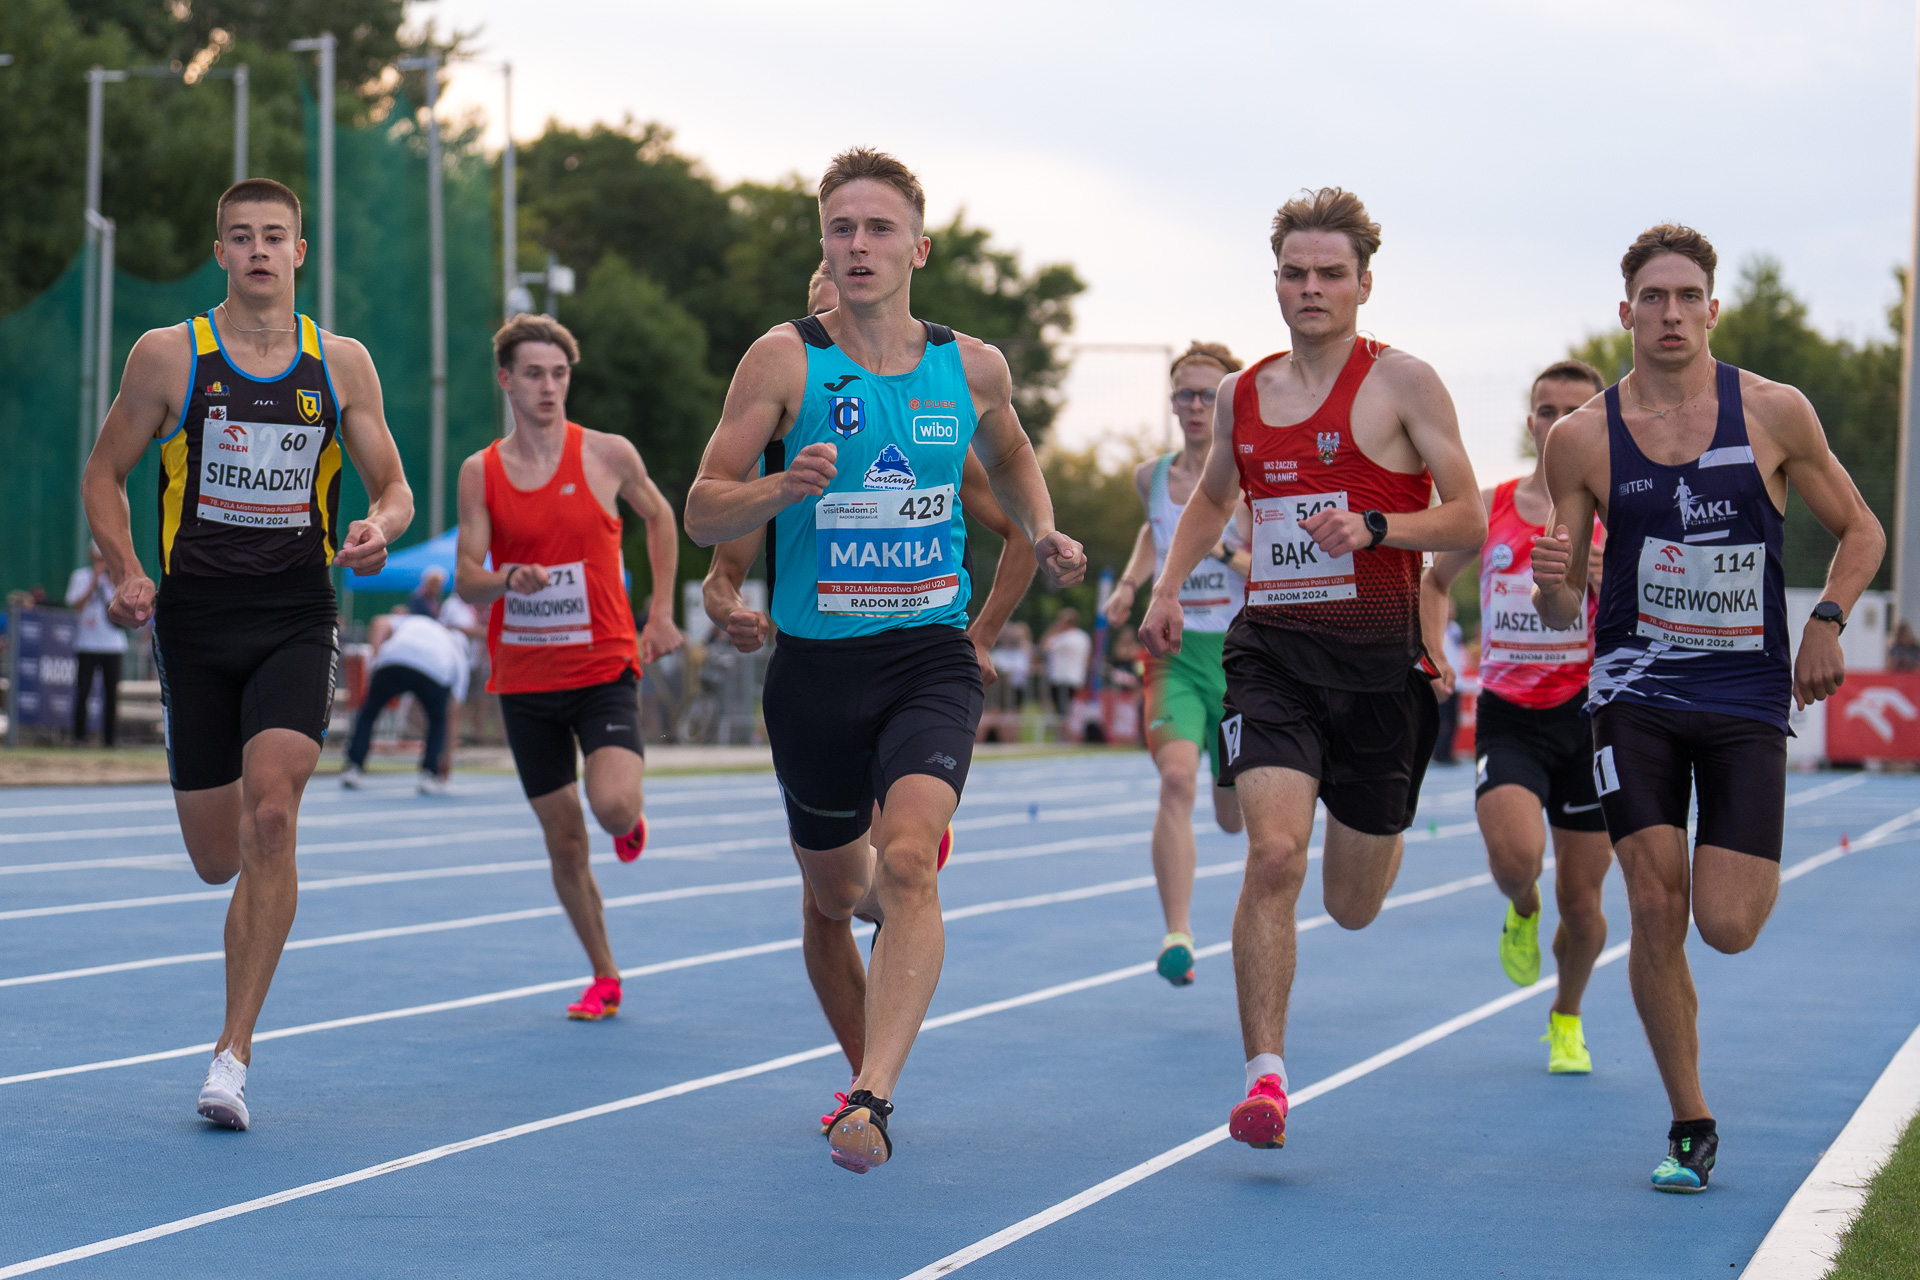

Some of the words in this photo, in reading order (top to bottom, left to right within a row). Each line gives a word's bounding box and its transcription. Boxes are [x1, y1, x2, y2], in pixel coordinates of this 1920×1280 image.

[925, 400, 956, 409] CUBE
[920, 422, 953, 437] wibo
[218, 443, 248, 452] ORLEN
[281, 432, 307, 451] 60
[206, 461, 311, 491] SIERADZKI
[864, 469, 916, 490] Kartuzy
[220, 501, 235, 510] PZLA
[236, 504, 276, 512] Mistrzostwa
[823, 506, 878, 514] visitRadom.pl
[899, 494, 945, 520] 423
[1686, 500, 1738, 520] MKL
[224, 512, 264, 524] RADOM
[266, 516, 289, 524] 2024
[830, 537, 943, 568] MAKIŁA
[1272, 541, 1318, 569] BĄK
[1654, 563, 1685, 574] ORLEN
[1714, 552, 1755, 574] 114
[548, 570, 575, 586] 71
[913, 582, 931, 592] Polski
[932, 580, 946, 588] U20
[851, 598, 898, 608] RADOM
[902, 596, 930, 607] 2024
[1268, 592, 1300, 602] RADOM
[1302, 590, 1328, 599] 2024
[1643, 583, 1758, 614] CZERWONKA
[1495, 611, 1583, 632] JASZEI
[1675, 624, 1716, 634] Mistrzostwa
[1663, 632, 1704, 646] RADOM
[1707, 639, 1734, 648] 2024
[1229, 720, 1238, 758] 2
[1595, 754, 1607, 791] 1
